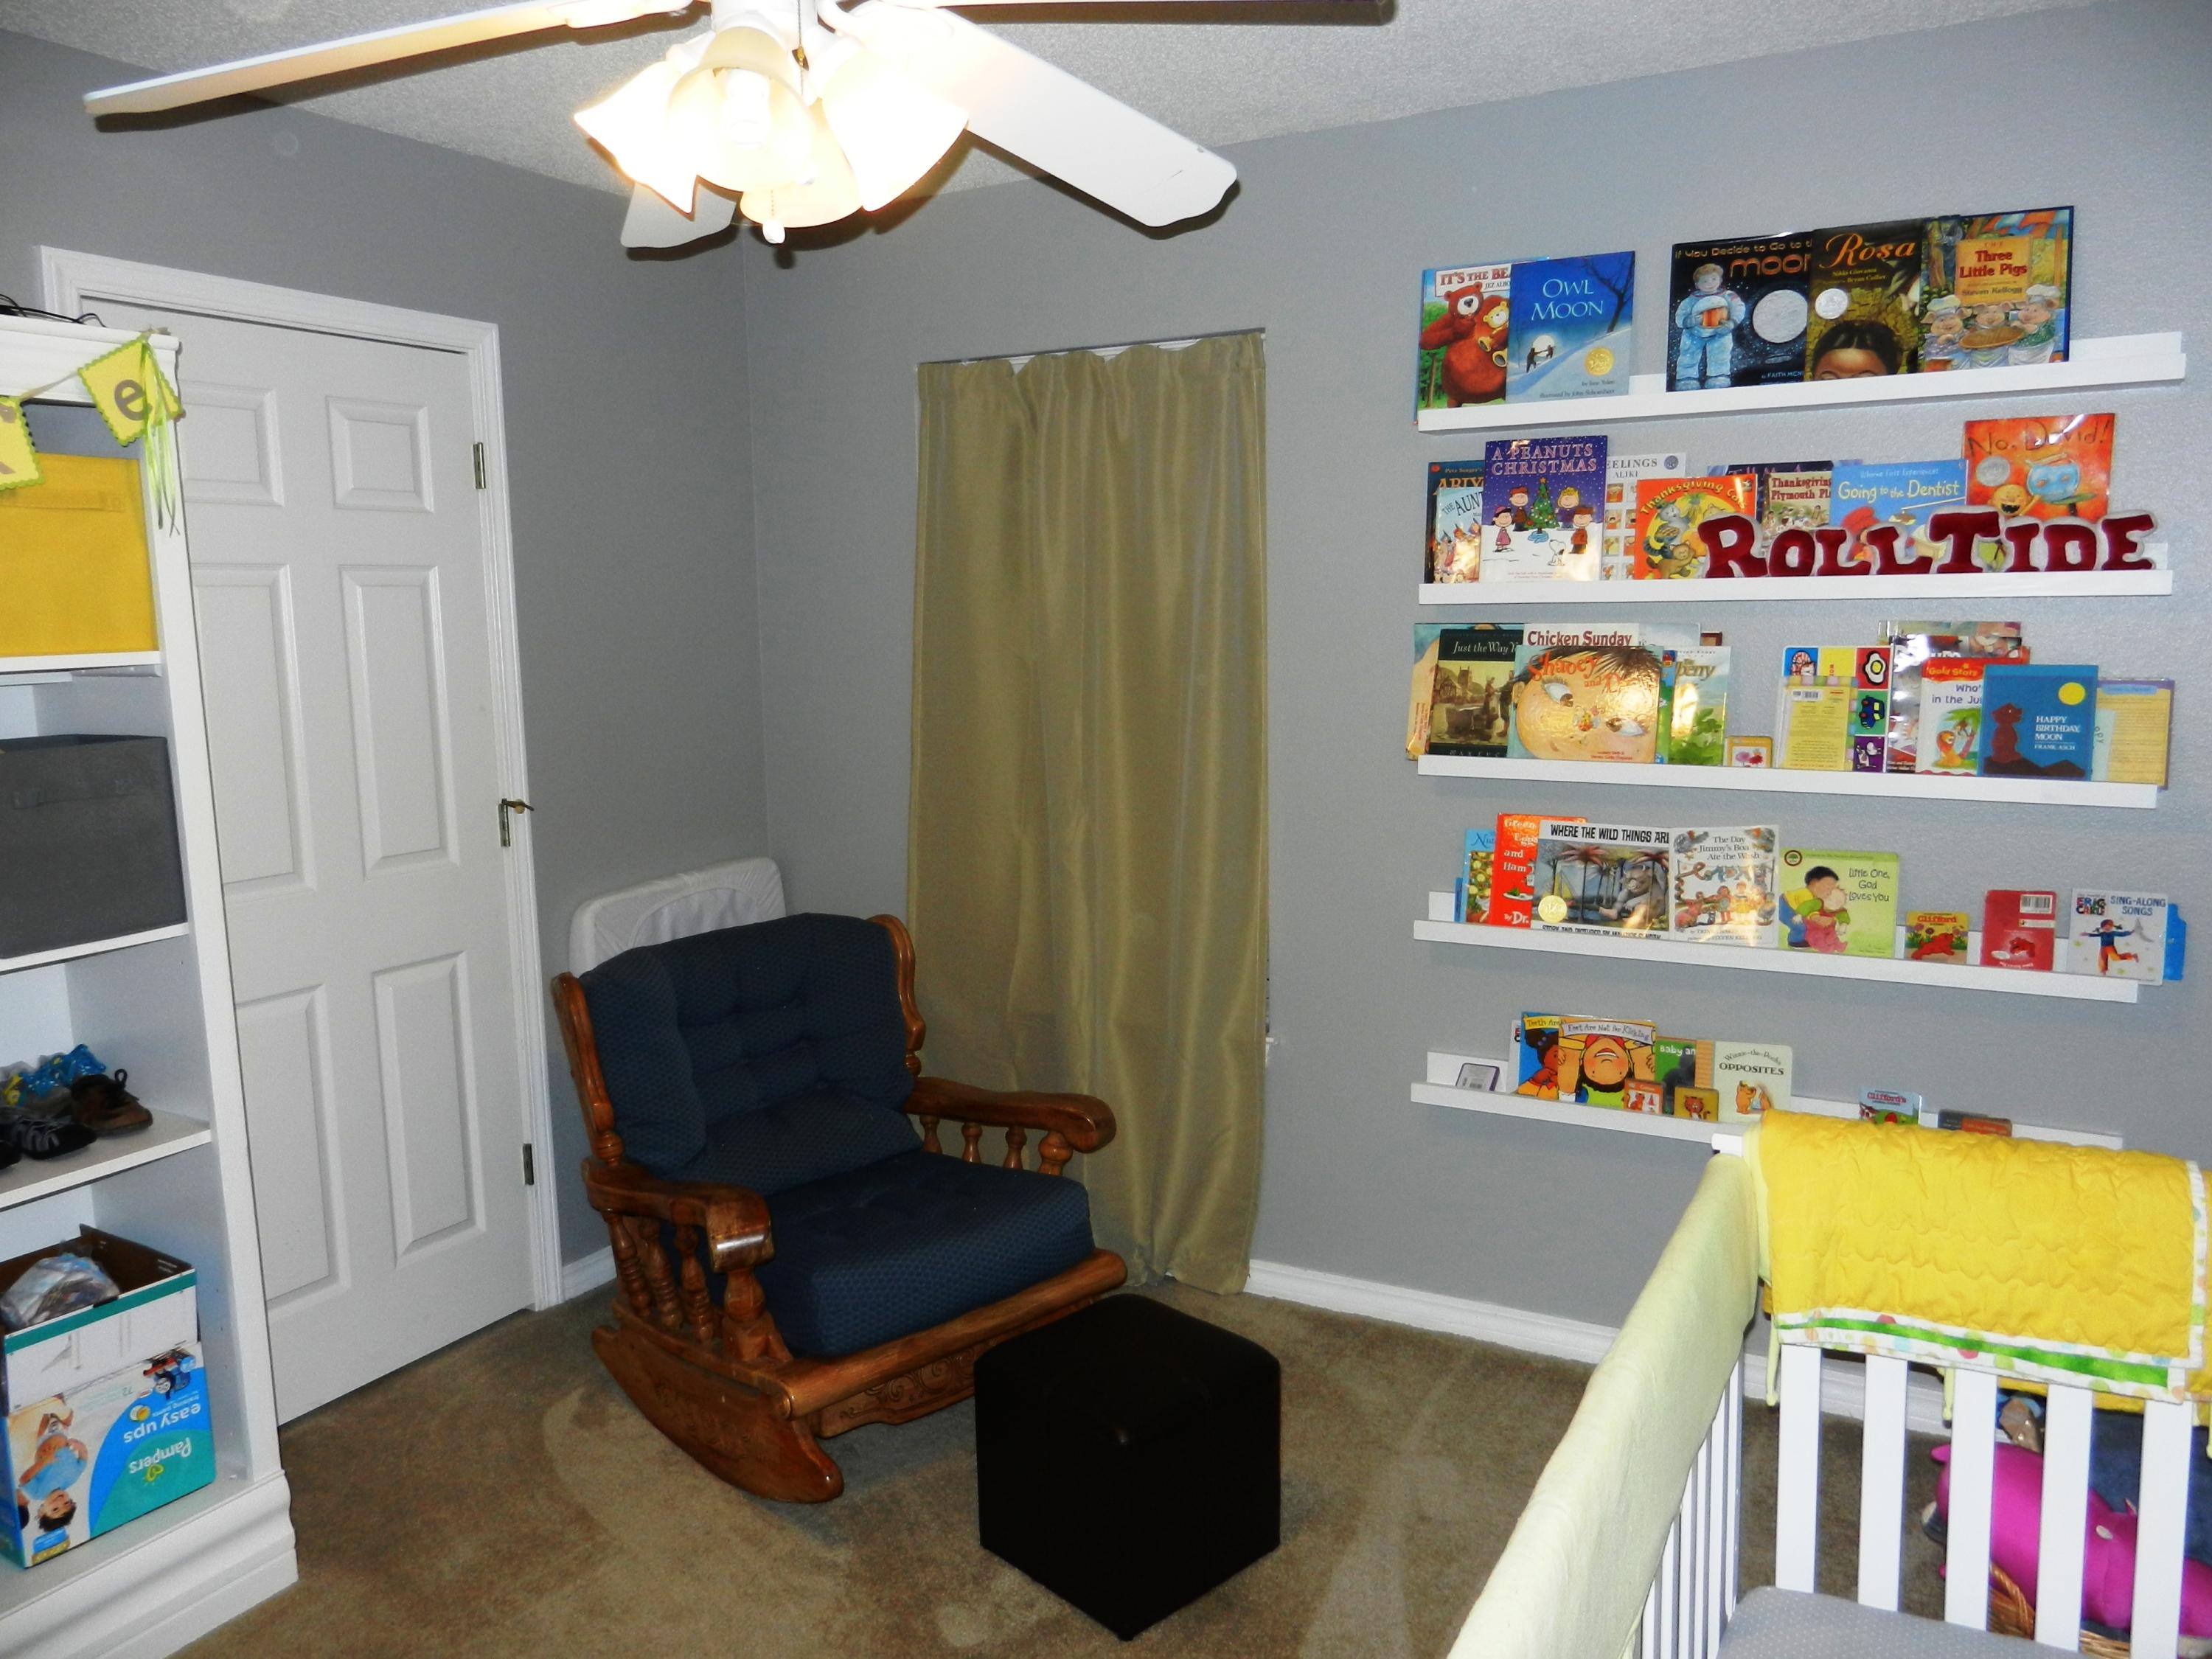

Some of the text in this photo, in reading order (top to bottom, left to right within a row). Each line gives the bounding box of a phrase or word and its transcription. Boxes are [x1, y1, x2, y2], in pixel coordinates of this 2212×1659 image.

[1675, 250, 1682, 258] If
[1686, 249, 1708, 258] You
[1711, 245, 1750, 256] Decide
[1770, 242, 1785, 251] Go
[1818, 232, 1916, 269] Rosa
[1975, 250, 2013, 262] Three
[1440, 268, 1511, 286] IT'S THE BE
[1959, 263, 2028, 278] Little Pigs
[1543, 278, 1595, 299] OWL
[1531, 300, 1604, 321] MOON
[2025, 418, 2111, 451] Dvid!
[1492, 443, 1593, 462] A PEANUTS
[1492, 459, 1597, 476] CHRISTMAS
[1641, 479, 1723, 515] Thanksgiving
[1838, 479, 1961, 504] Going to the Dentist
[1441, 503, 1455, 515] THE
[1697, 510, 2155, 578] ROLL TIDE
[1527, 630, 1579, 646] Chicken
[1582, 630, 1632, 647] Sunday
[1453, 641, 1471, 655] Just
[1473, 642, 1487, 653] the
[1487, 641, 1509, 655] Way
[1929, 666, 1951, 675] Gold
[1585, 675, 1602, 688] and
[1932, 694, 1982, 705] in the Ju
[2036, 715, 2067, 723] HAPPY
[2035, 733, 2063, 741] MOON
[1504, 818, 1536, 830] Green
[1514, 832, 1539, 847] Eggs
[1551, 824, 1578, 838] WHERE
[1582, 826, 1596, 839] THE
[1599, 827, 1618, 841] WILD
[1621, 829, 1652, 842] THINGS
[1713, 835, 1746, 844] The Day
[1504, 849, 1524, 858] and
[1699, 844, 1732, 853] Jimmy's
[1737, 852, 1760, 860] Wsh
[1504, 862, 1526, 872] Ham
[1848, 867, 1868, 878] Little
[1858, 880, 1878, 890] God
[1848, 891, 1890, 902] Loves You
[2110, 895, 2166, 908] SING-ALONG
[1512, 910, 1529, 925] Dr.
[2122, 906, 2153, 916] SONGS
[1568, 1023, 1580, 1032] Feet
[1585, 1023, 1596, 1032] Are
[1660, 1045, 1683, 1057] Baby
[1719, 1062, 1784, 1076] OPPOSITES
[123, 1402, 201, 1444] easy ups
[129, 1437, 192, 1473] Pampers
